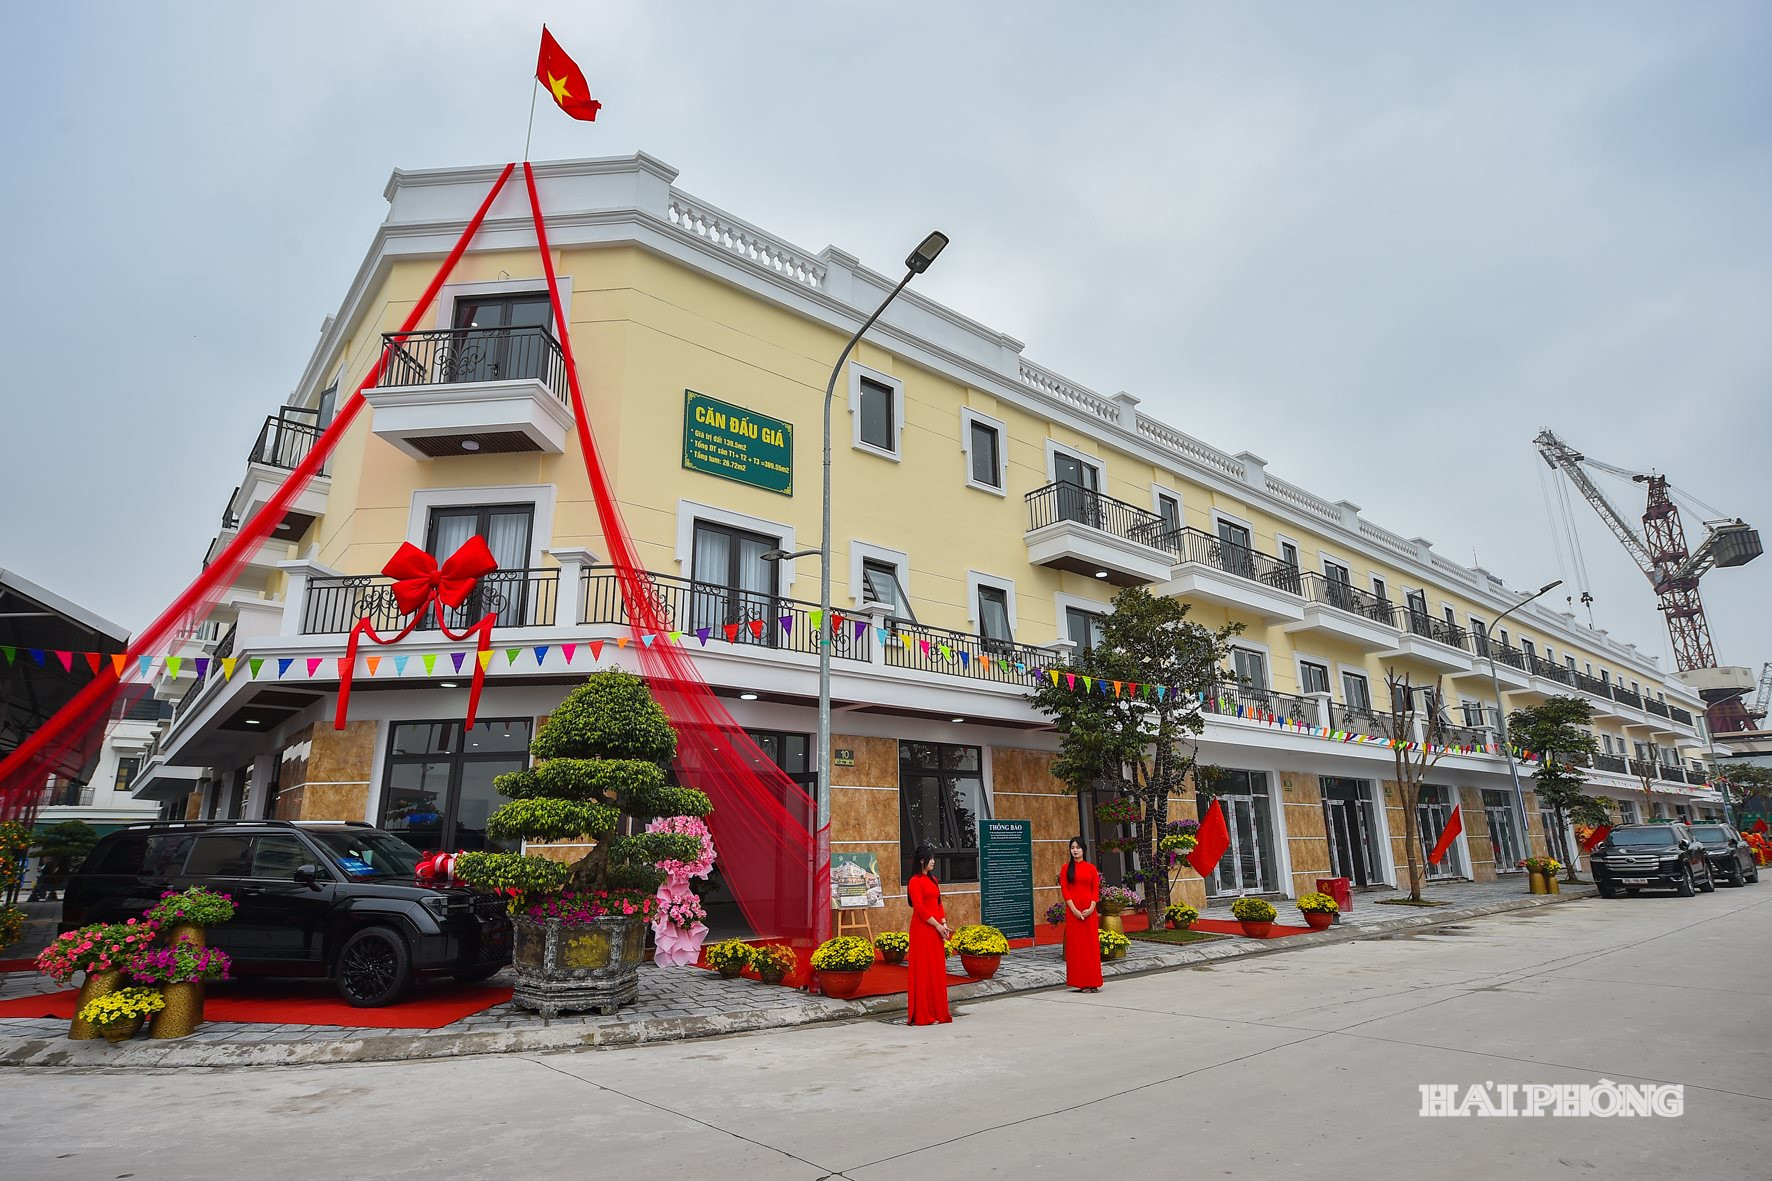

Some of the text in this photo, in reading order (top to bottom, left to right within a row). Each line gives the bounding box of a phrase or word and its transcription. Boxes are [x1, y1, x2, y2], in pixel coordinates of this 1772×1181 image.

[695, 406, 784, 448] CĂN ĐẤU GIÁ
[840, 750, 850, 758] 10
[988, 822, 1023, 831] THÔNG BÁO
